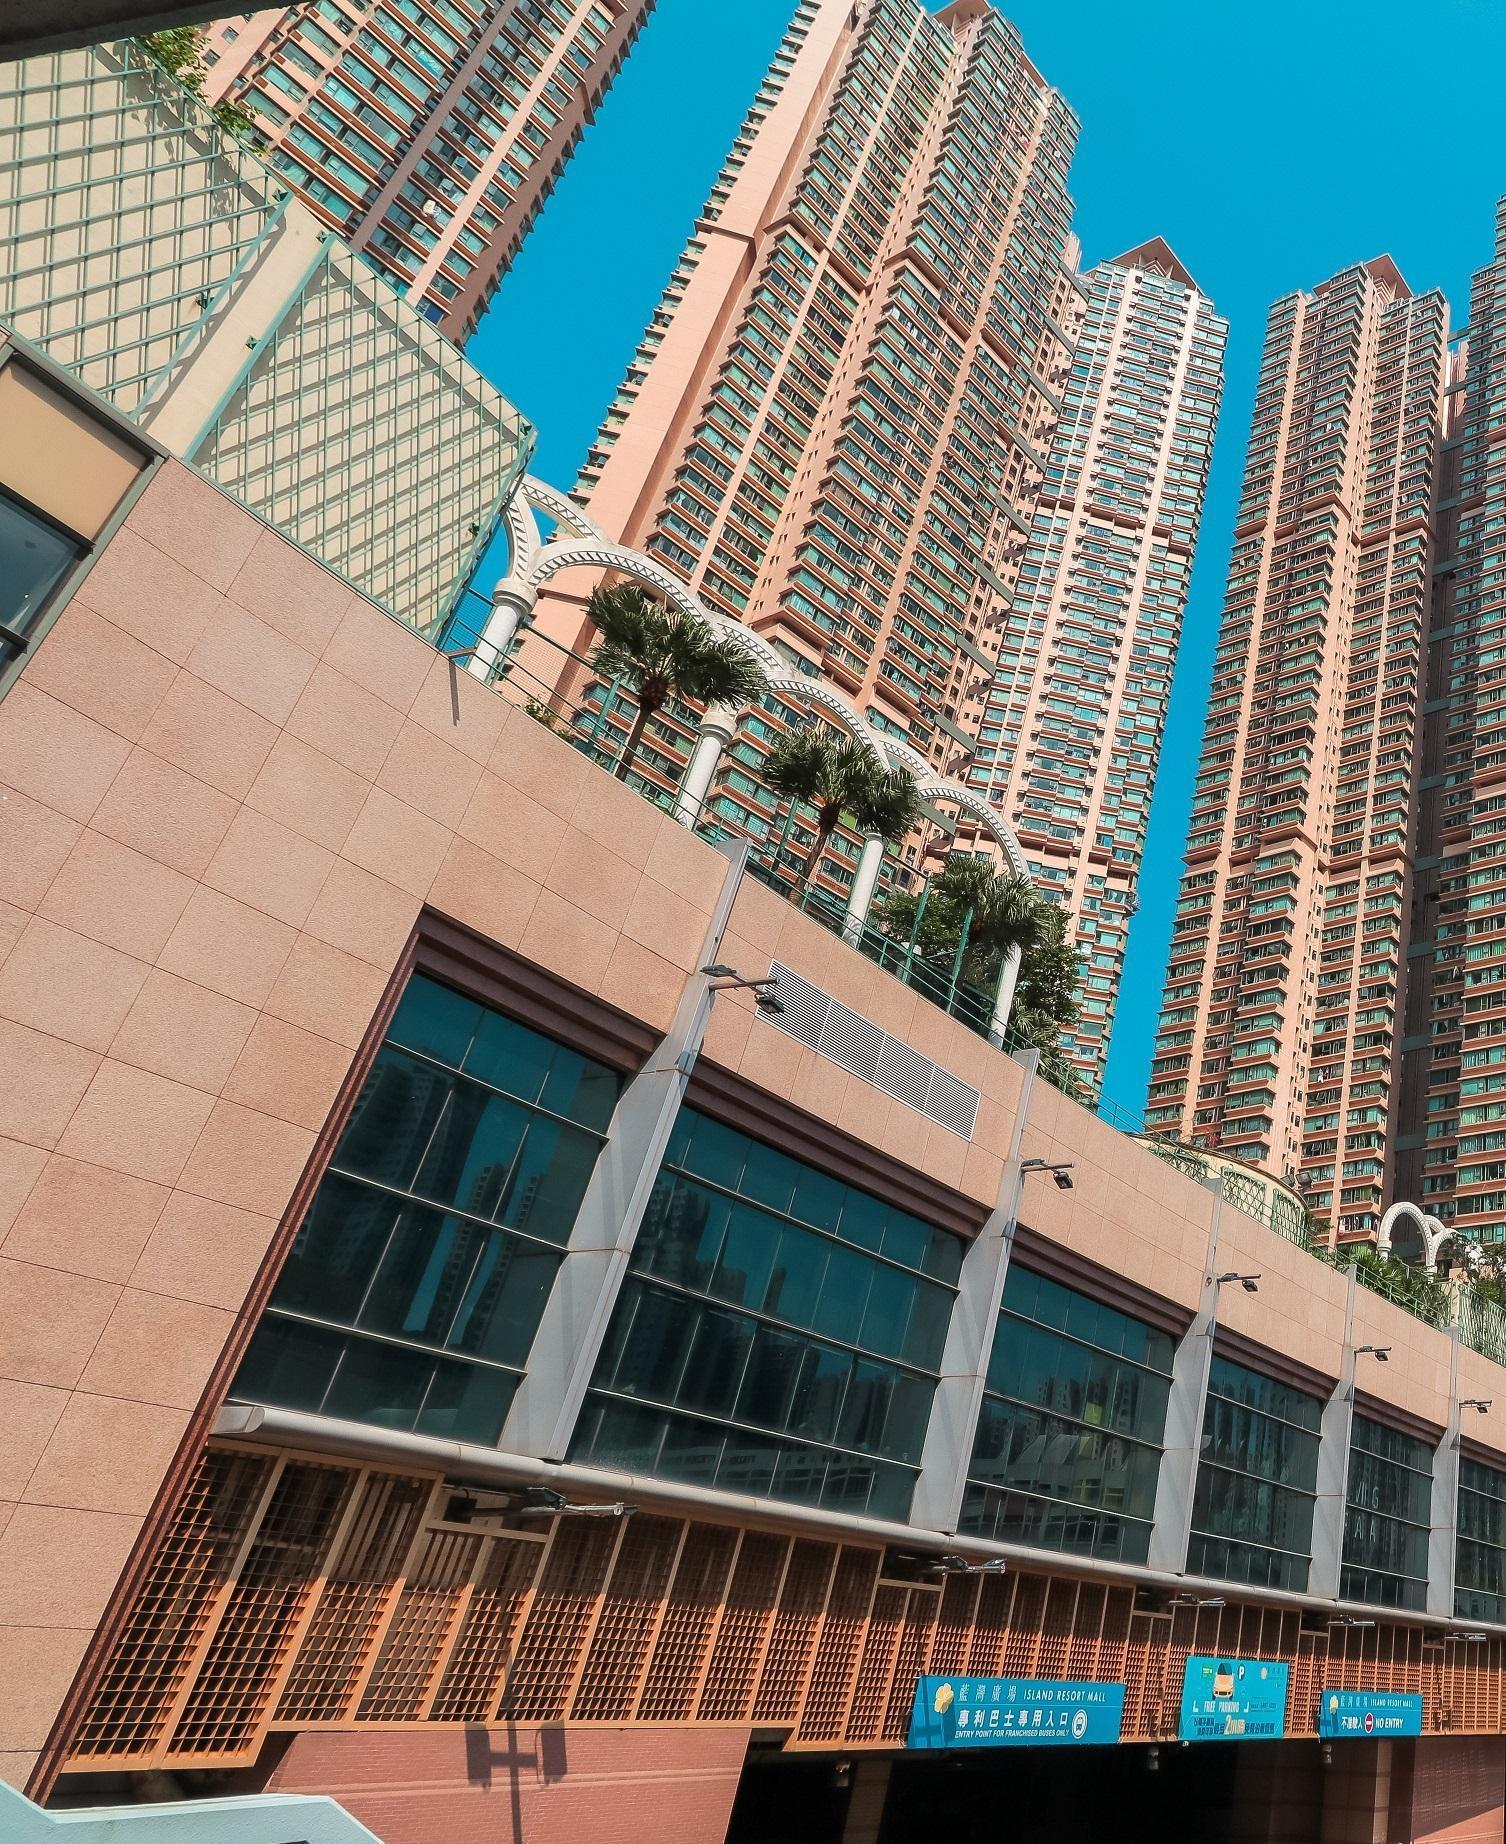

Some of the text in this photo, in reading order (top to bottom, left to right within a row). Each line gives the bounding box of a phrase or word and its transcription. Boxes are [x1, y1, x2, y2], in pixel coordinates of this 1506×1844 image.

[1023, 1688, 1054, 1701] ISLAND
[1056, 1689, 1086, 1701] RESORT
[1087, 1690, 1106, 1702] MALL
[1203, 1700, 1216, 1713] FREE
[957, 1709, 1069, 1728] 專利巴士專用入口
[1375, 1717, 1404, 1729] NO ENTRY
[955, 1729, 1070, 1739] ENTRY POINT FOR FRANCHISED BUSES ONLY
